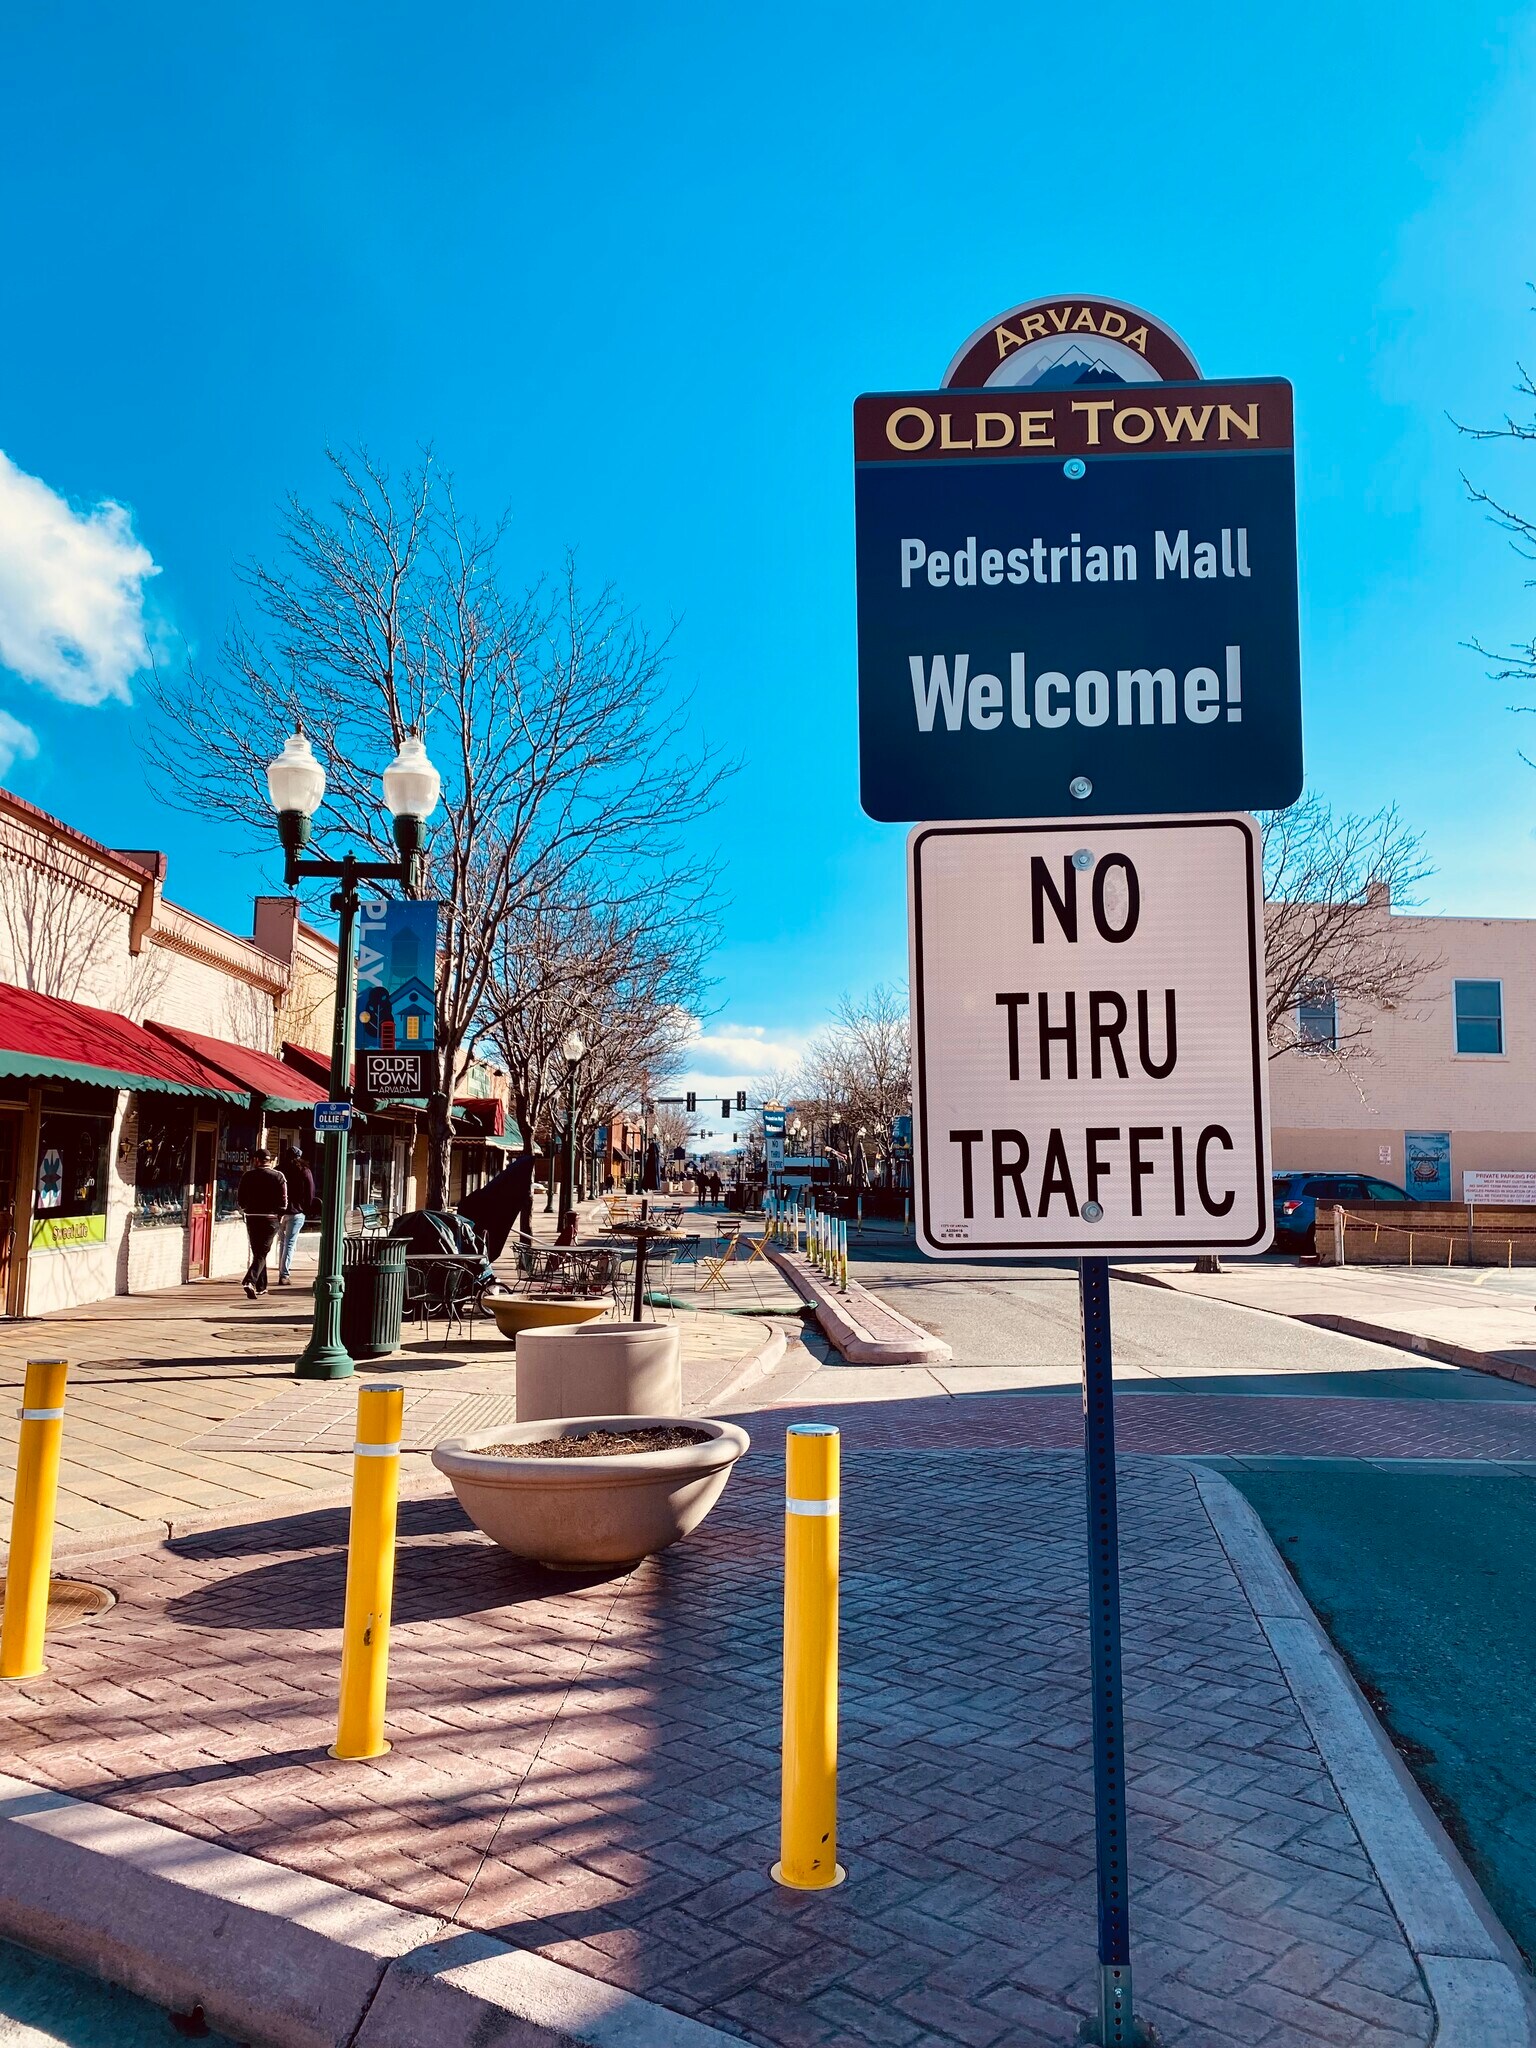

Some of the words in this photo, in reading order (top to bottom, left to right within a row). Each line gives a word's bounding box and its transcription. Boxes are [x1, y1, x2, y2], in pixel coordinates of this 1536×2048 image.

[993, 306, 1149, 358] ARVADA
[885, 406, 1056, 452] OLDE
[1071, 399, 1261, 446] TOWN
[900, 532, 1138, 588] Pedestrian
[1154, 527, 1252, 580] Mall
[908, 645, 1243, 733] Welcome!
[1030, 852, 1141, 944] NO
[358, 900, 388, 987] PLAY
[995, 988, 1178, 1081] THRU
[369, 1072, 418, 1085] TOWN
[372, 1058, 415, 1072] OLDE
[378, 1085, 411, 1094] ARVADA
[949, 1123, 1236, 1219] TRAFFIC
[52, 1224, 74, 1241] Sweet
[75, 1223, 88, 1238] Life
